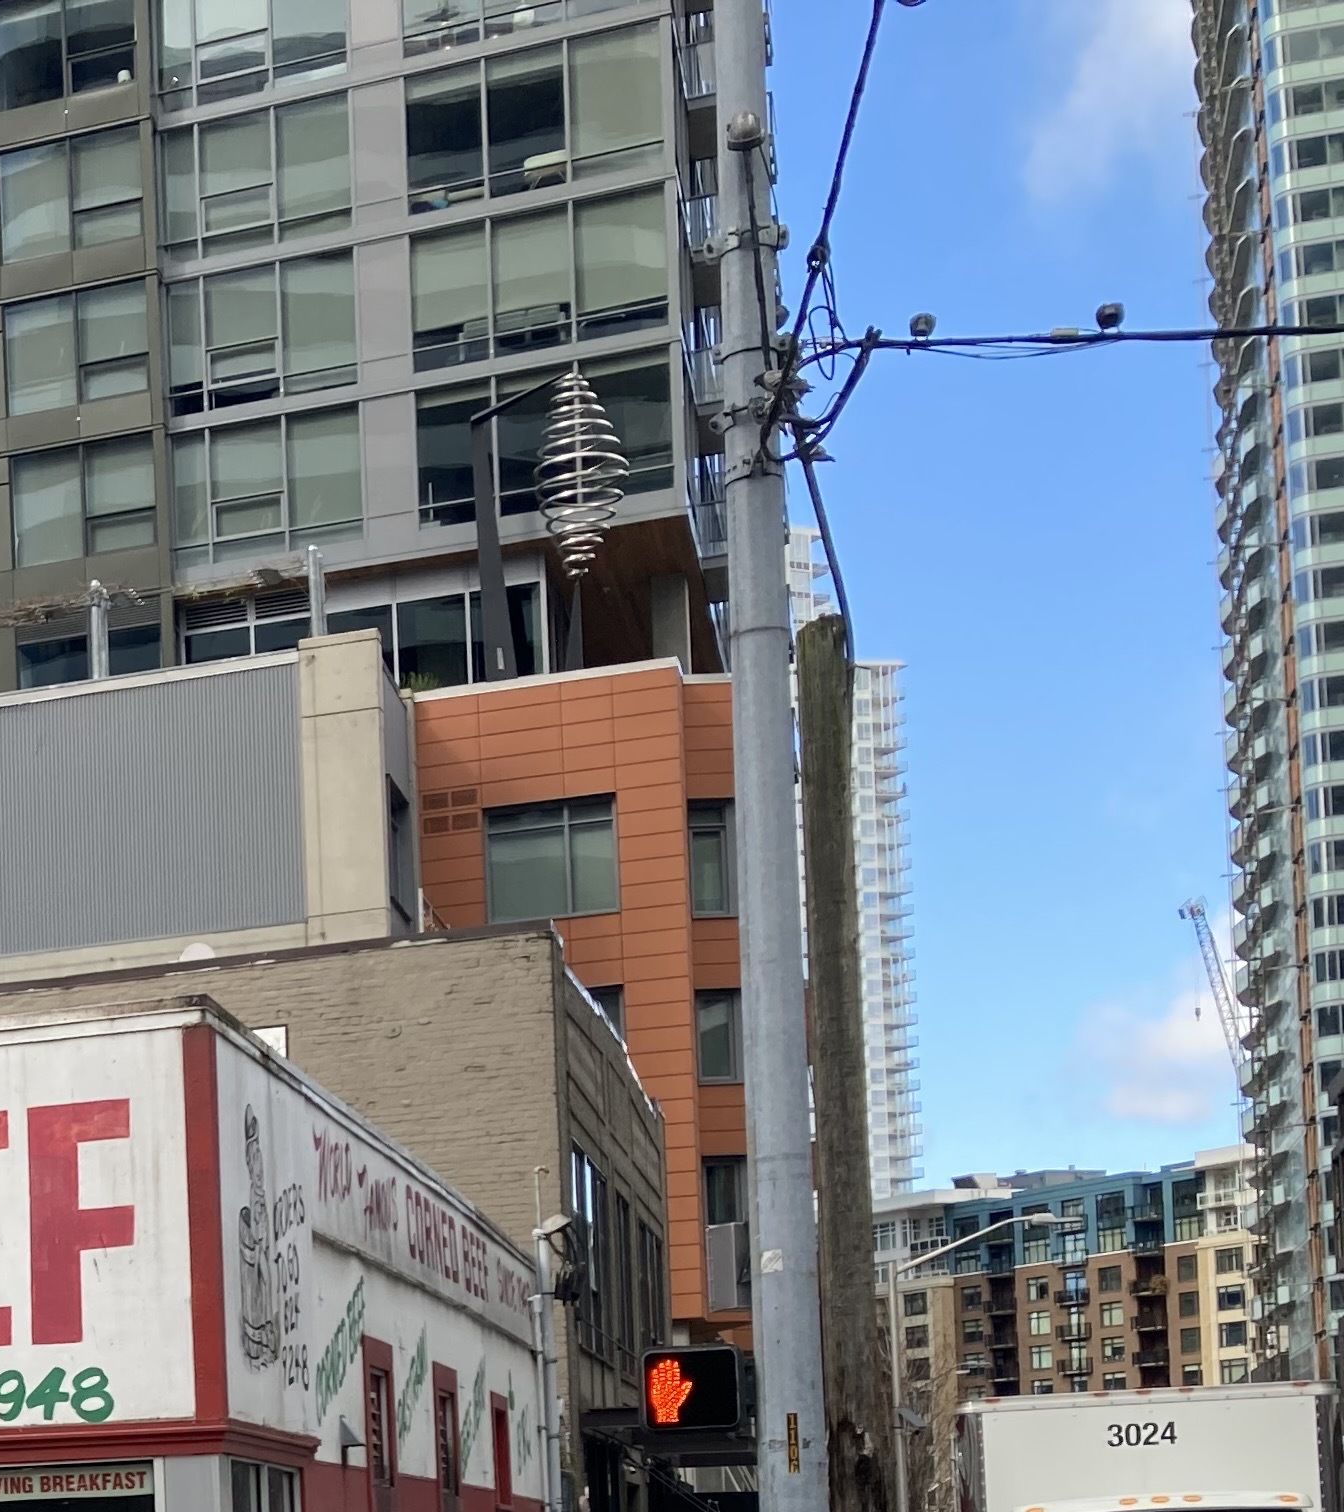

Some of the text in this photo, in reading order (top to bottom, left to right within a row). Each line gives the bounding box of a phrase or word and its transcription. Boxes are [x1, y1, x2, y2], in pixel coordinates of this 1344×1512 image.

[405, 1183, 460, 1284] CORNED
[462, 1224, 489, 1302] BEEF
[1106, 1420, 1179, 1448] 3024
[40, 1471, 148, 1493] BREAKFAST
